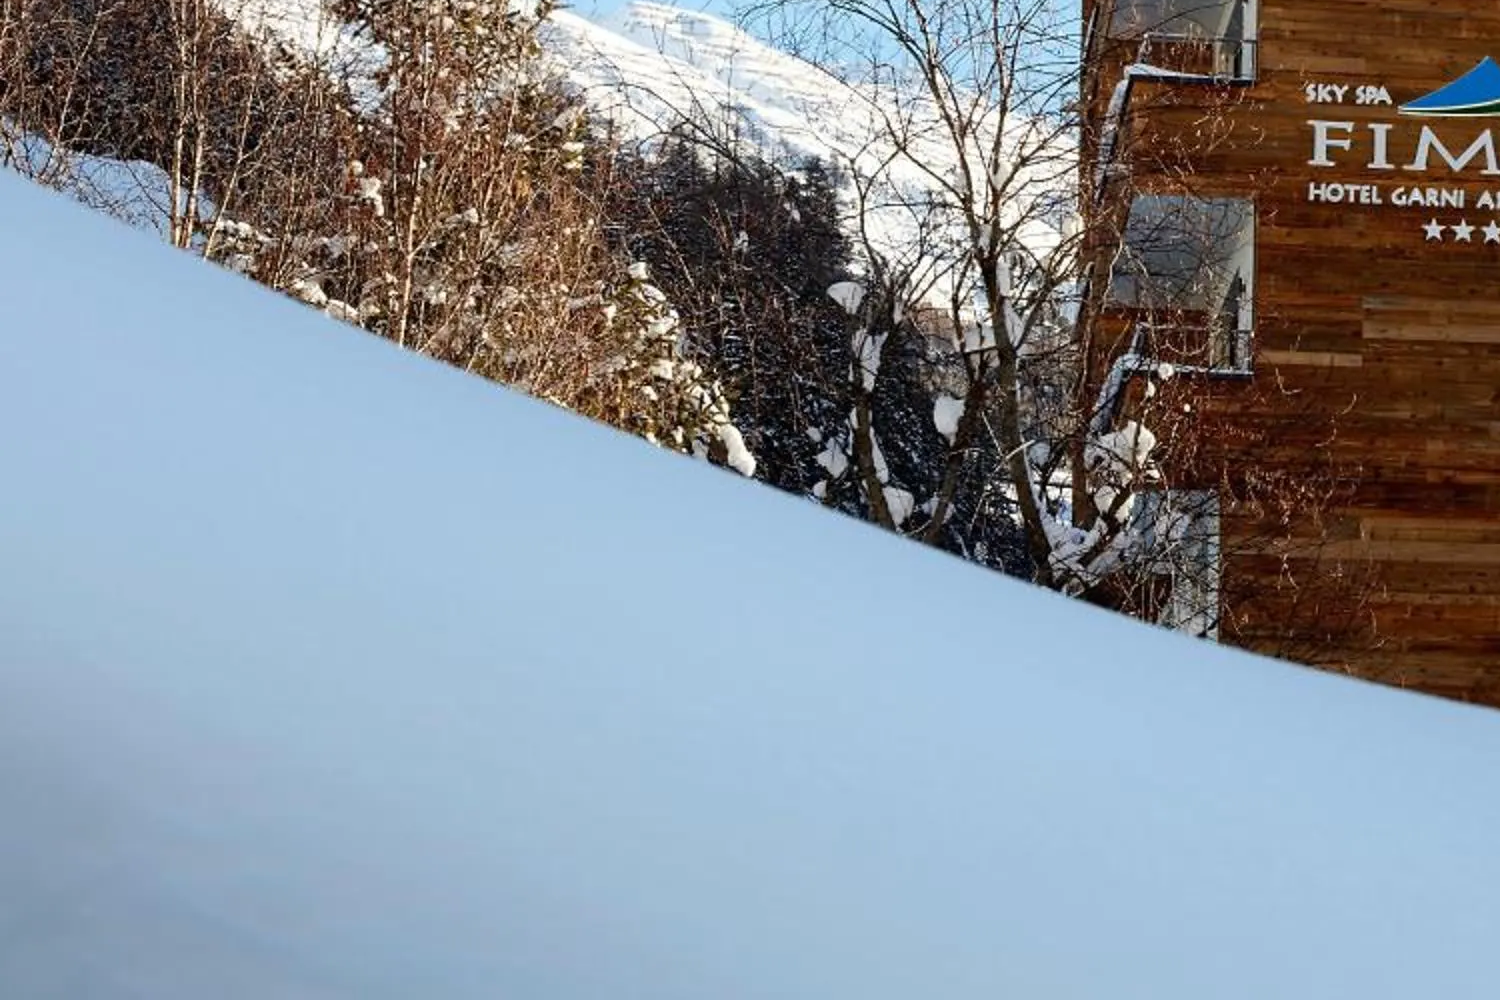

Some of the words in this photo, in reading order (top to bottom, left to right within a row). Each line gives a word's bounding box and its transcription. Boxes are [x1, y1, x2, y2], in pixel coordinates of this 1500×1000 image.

[1305, 83, 1349, 104] SKY
[1355, 85, 1393, 105] SPA
[1308, 182, 1382, 205] HOTEL
[1391, 187, 1465, 209] GARNI
